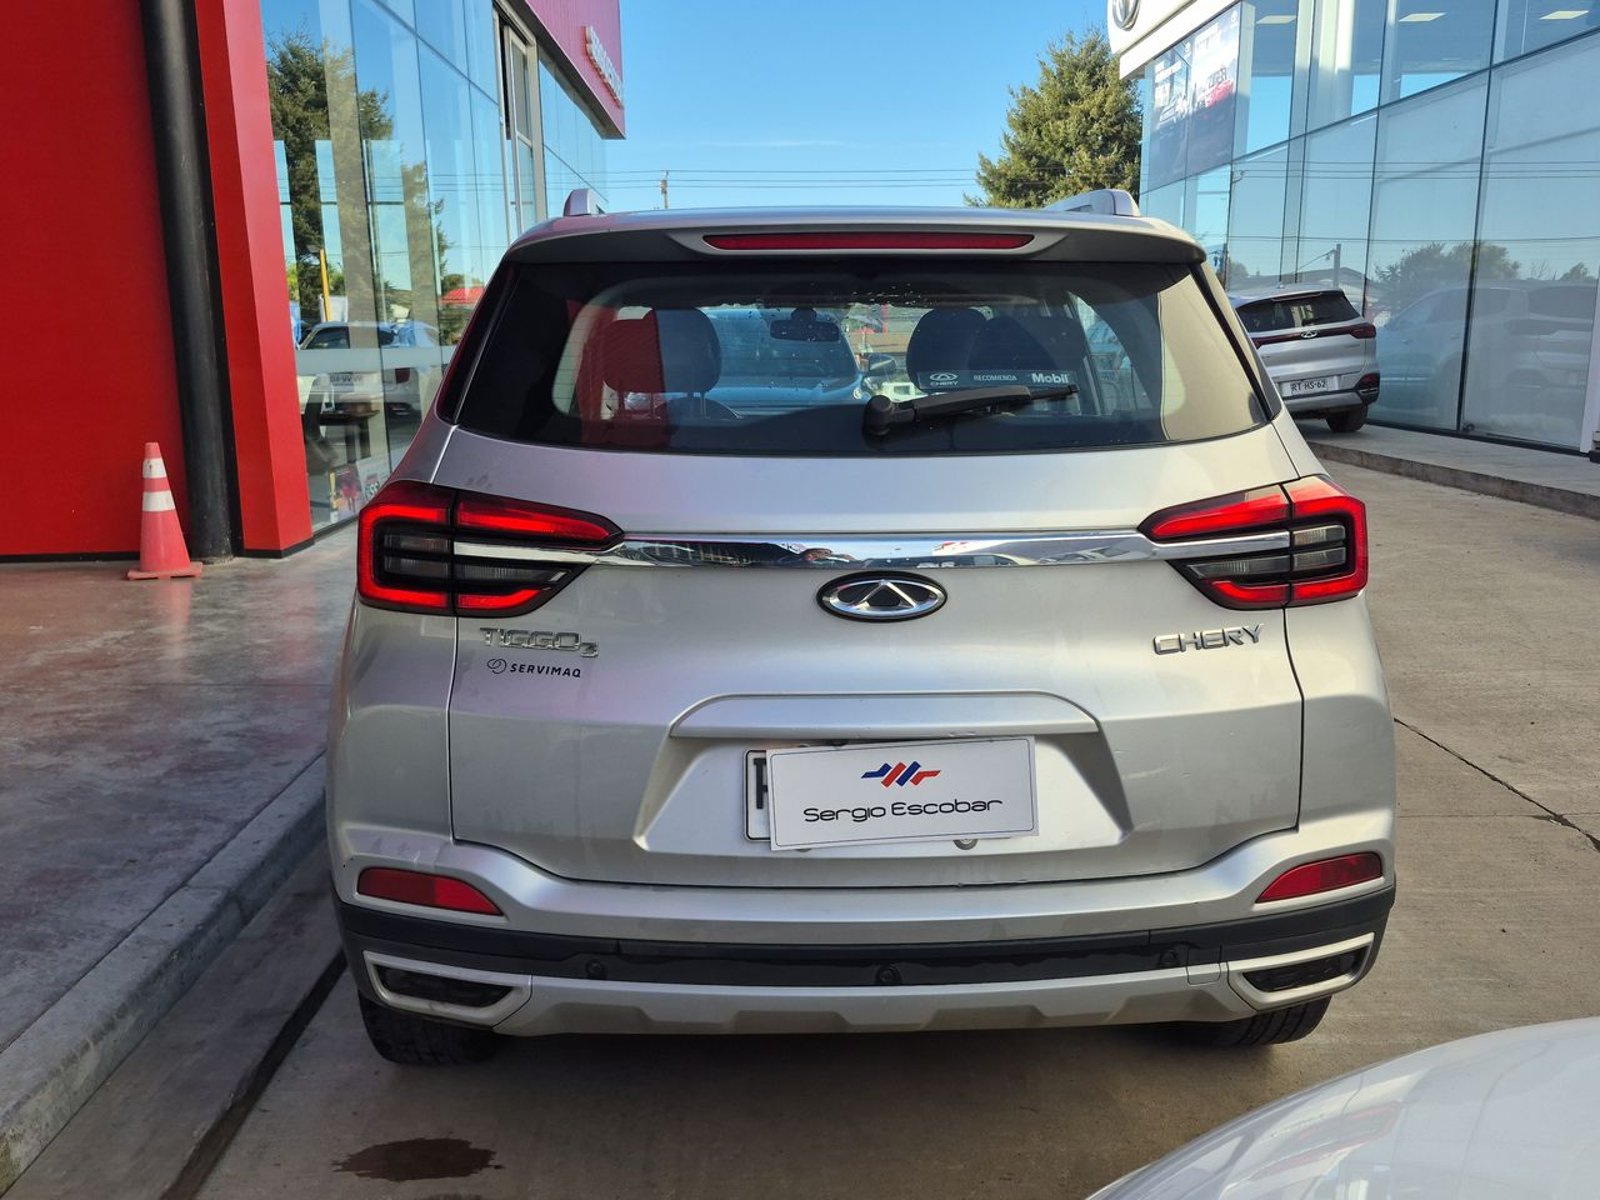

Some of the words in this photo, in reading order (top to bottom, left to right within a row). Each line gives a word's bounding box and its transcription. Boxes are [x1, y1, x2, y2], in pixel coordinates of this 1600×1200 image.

[1031, 372, 1071, 384] Mobil
[480, 627, 581, 651] TIGGO
[1153, 623, 1264, 655] CHERY
[509, 663, 582, 679] SERVIMAQ
[803, 807, 886, 823] Sergio
[890, 798, 1003, 816] Escobar
